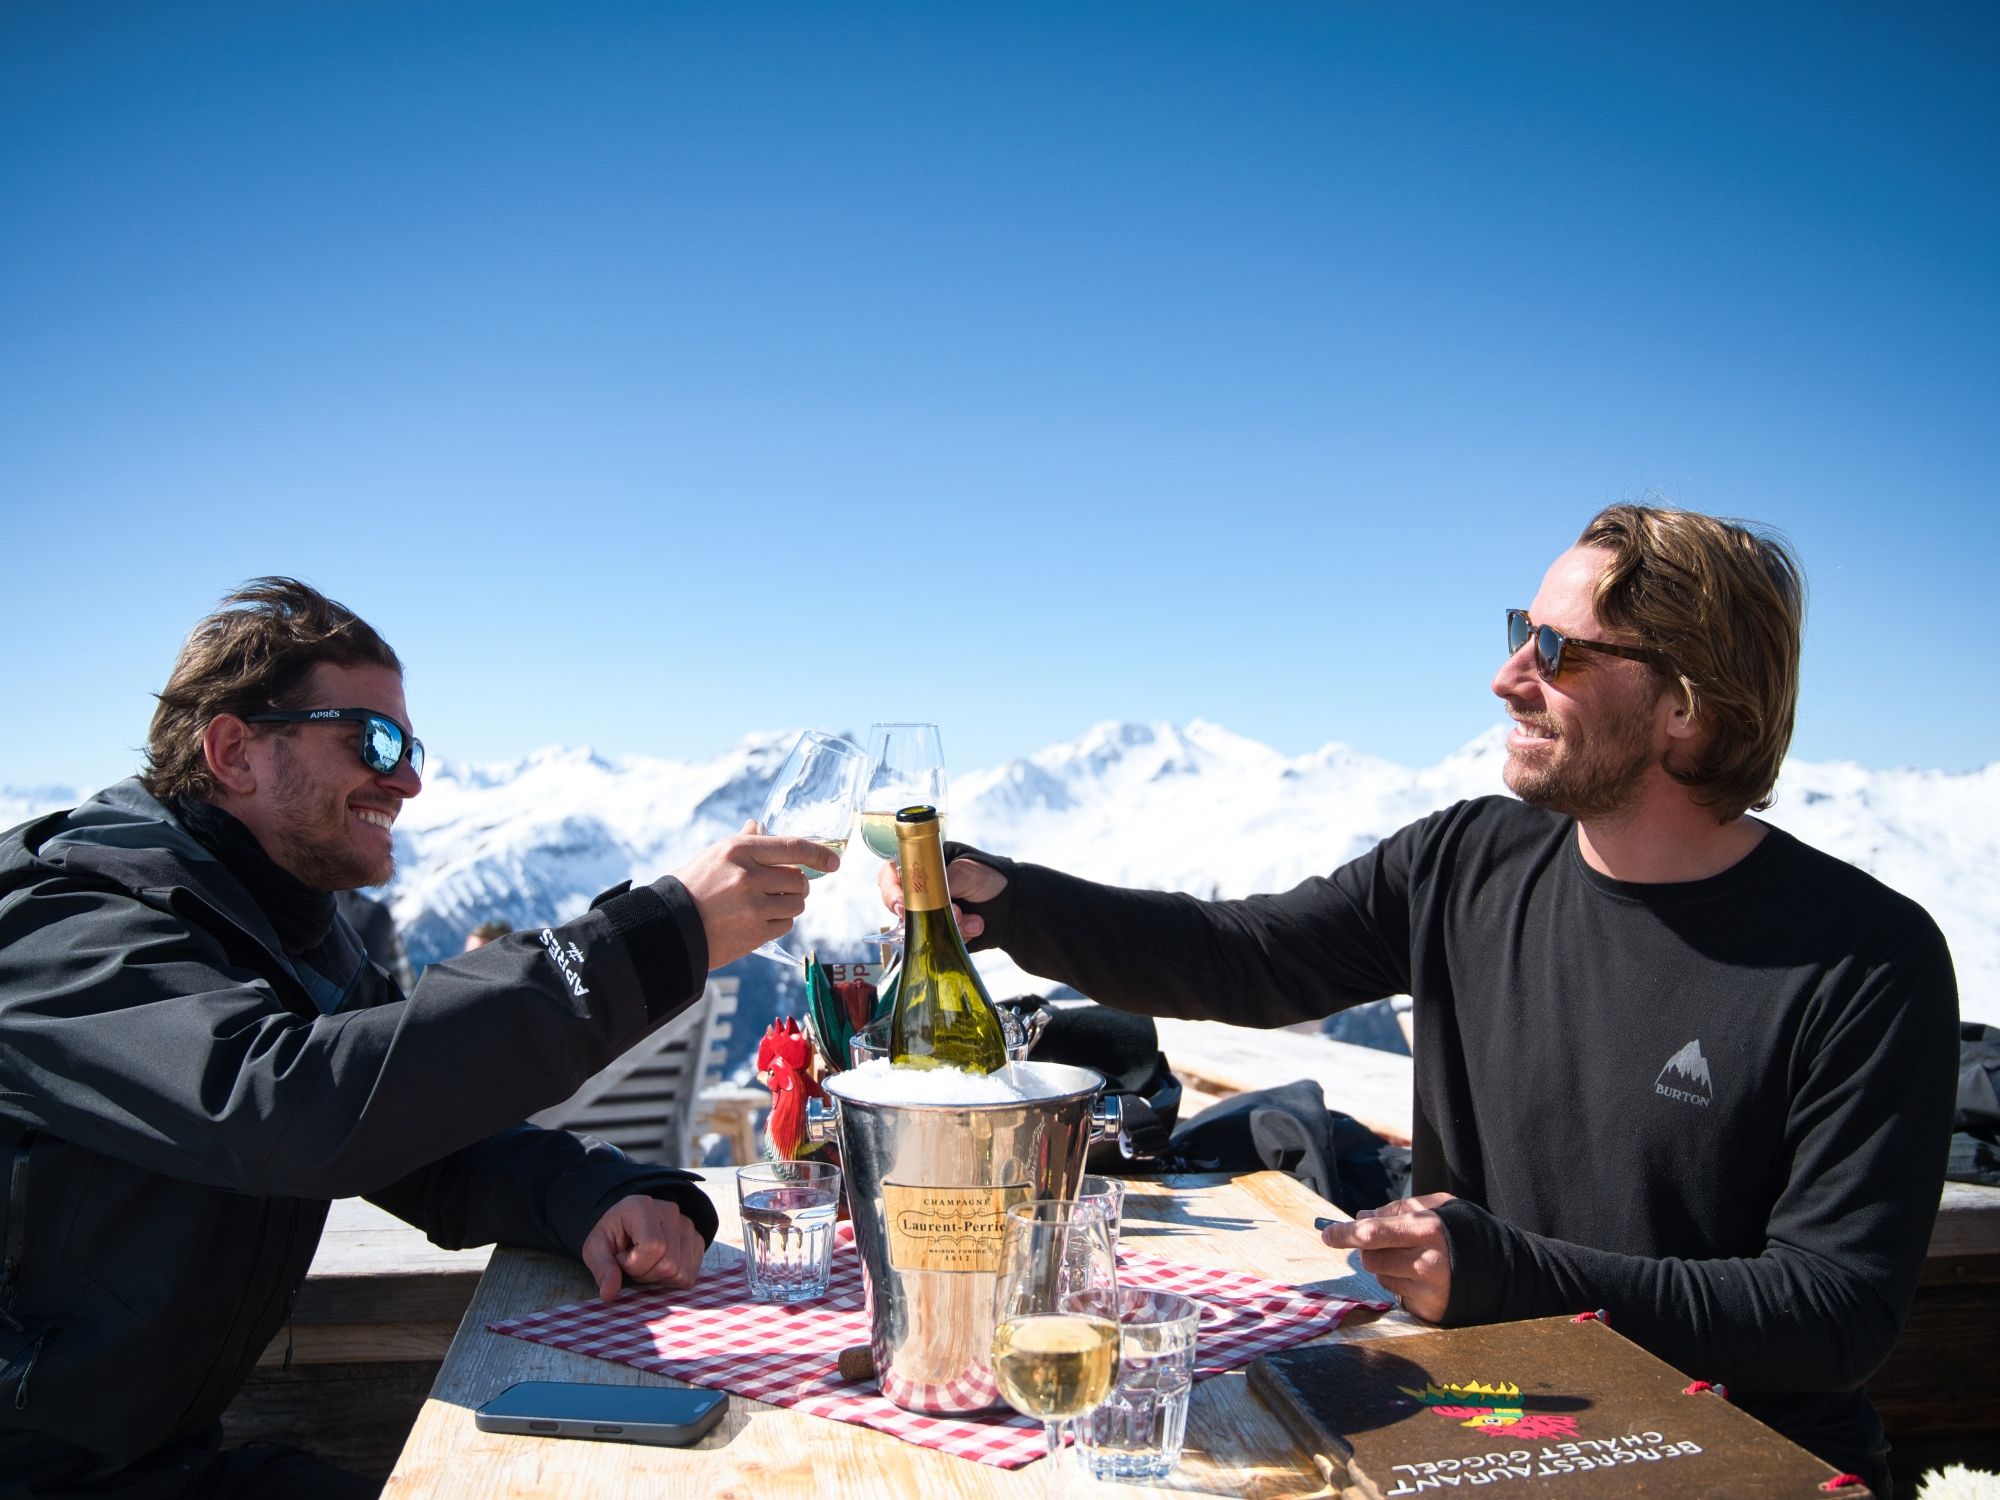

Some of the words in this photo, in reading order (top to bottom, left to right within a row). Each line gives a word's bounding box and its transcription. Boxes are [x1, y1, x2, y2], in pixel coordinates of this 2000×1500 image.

[1655, 1083, 1711, 1107] BURTON
[923, 1198, 990, 1206] CHAMPAGNE
[903, 1219, 1006, 1232] Laurent-Perrie
[1392, 1450, 1531, 1476] GÜGGEL
